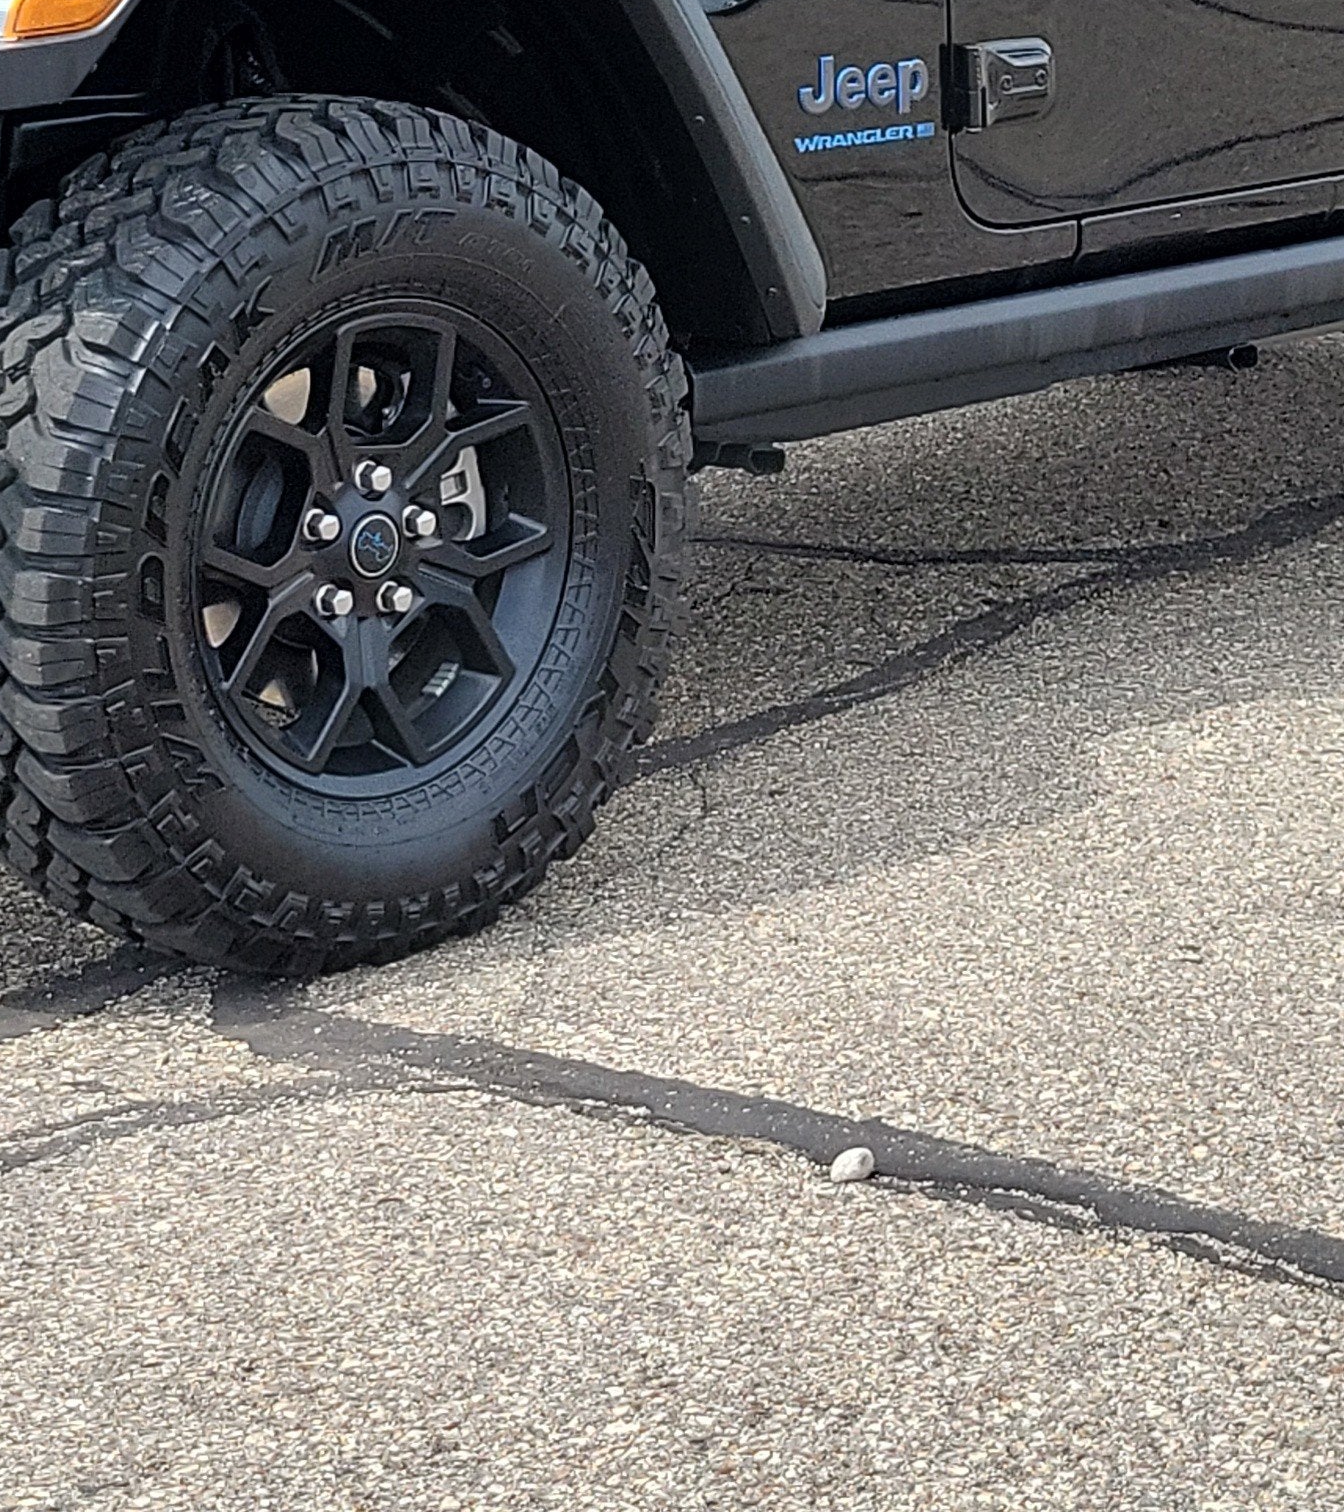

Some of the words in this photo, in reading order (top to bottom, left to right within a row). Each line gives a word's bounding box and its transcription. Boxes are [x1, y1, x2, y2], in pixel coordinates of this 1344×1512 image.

[797, 54, 930, 115] Jeep
[793, 124, 915, 154] WRANGLER
[308, 208, 456, 282] M/T
